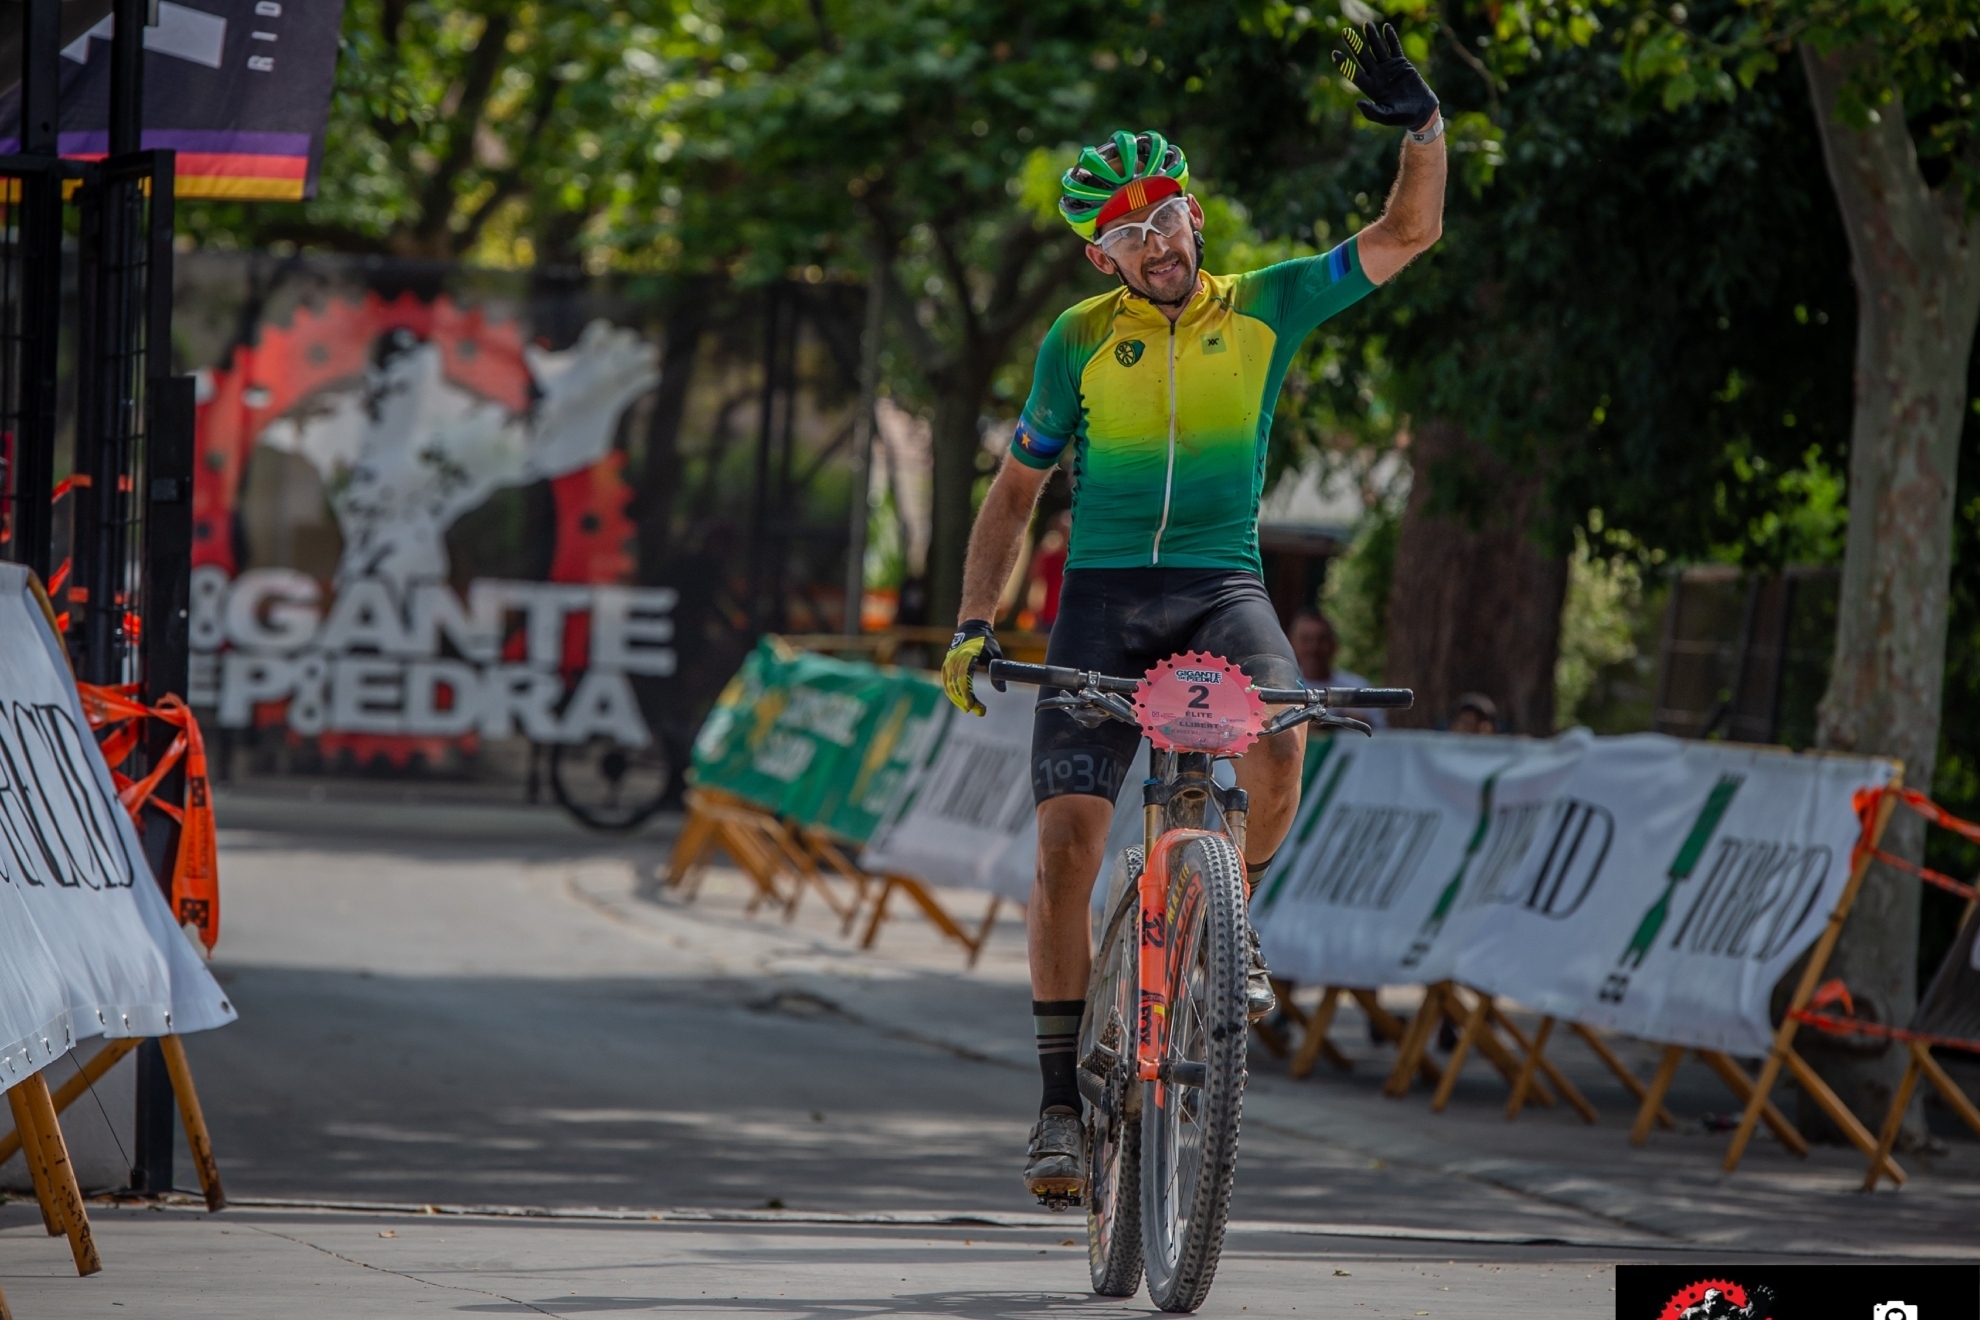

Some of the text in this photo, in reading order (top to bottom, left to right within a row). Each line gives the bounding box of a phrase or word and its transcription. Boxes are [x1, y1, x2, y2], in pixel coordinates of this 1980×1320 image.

[1185, 710, 1213, 719] ÉLITE
[1187, 684, 1210, 710] 2
[1167, 862, 1191, 926] MAXXIS
[1139, 1003, 1154, 1047] FOX
